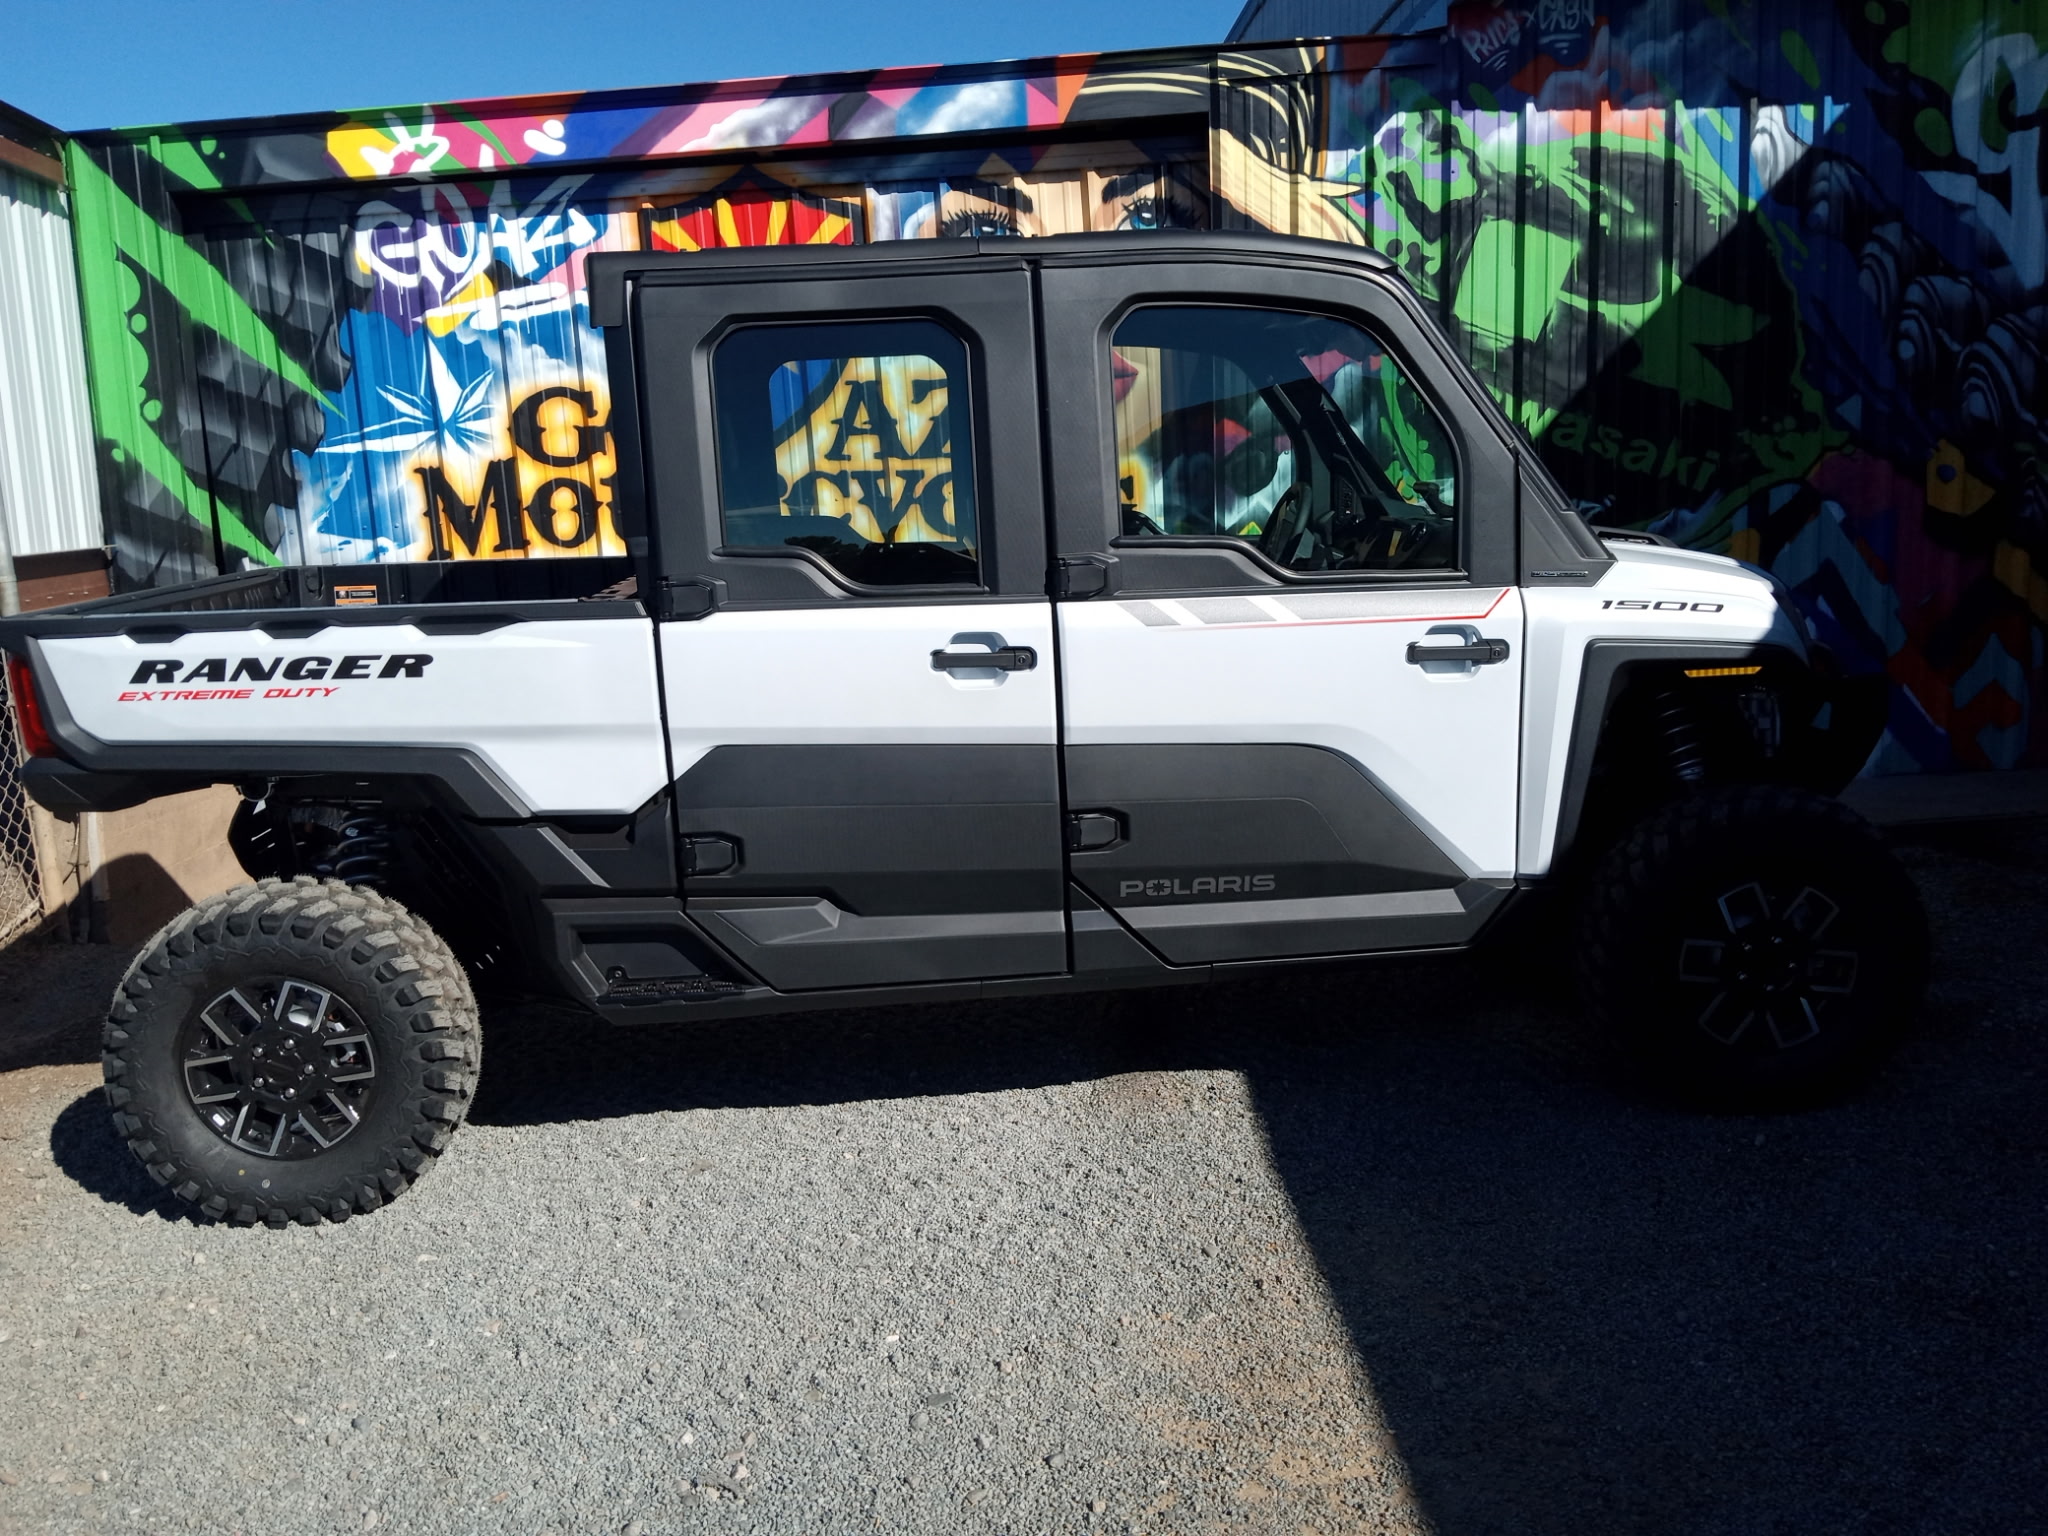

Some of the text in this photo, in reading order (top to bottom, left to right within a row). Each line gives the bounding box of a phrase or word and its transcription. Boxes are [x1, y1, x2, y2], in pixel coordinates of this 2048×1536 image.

[1602, 600, 1724, 613] 1500
[129, 653, 434, 684] RANGER
[117, 686, 341, 701] EXTREME DUTY
[1120, 874, 1276, 897] POLARIS
